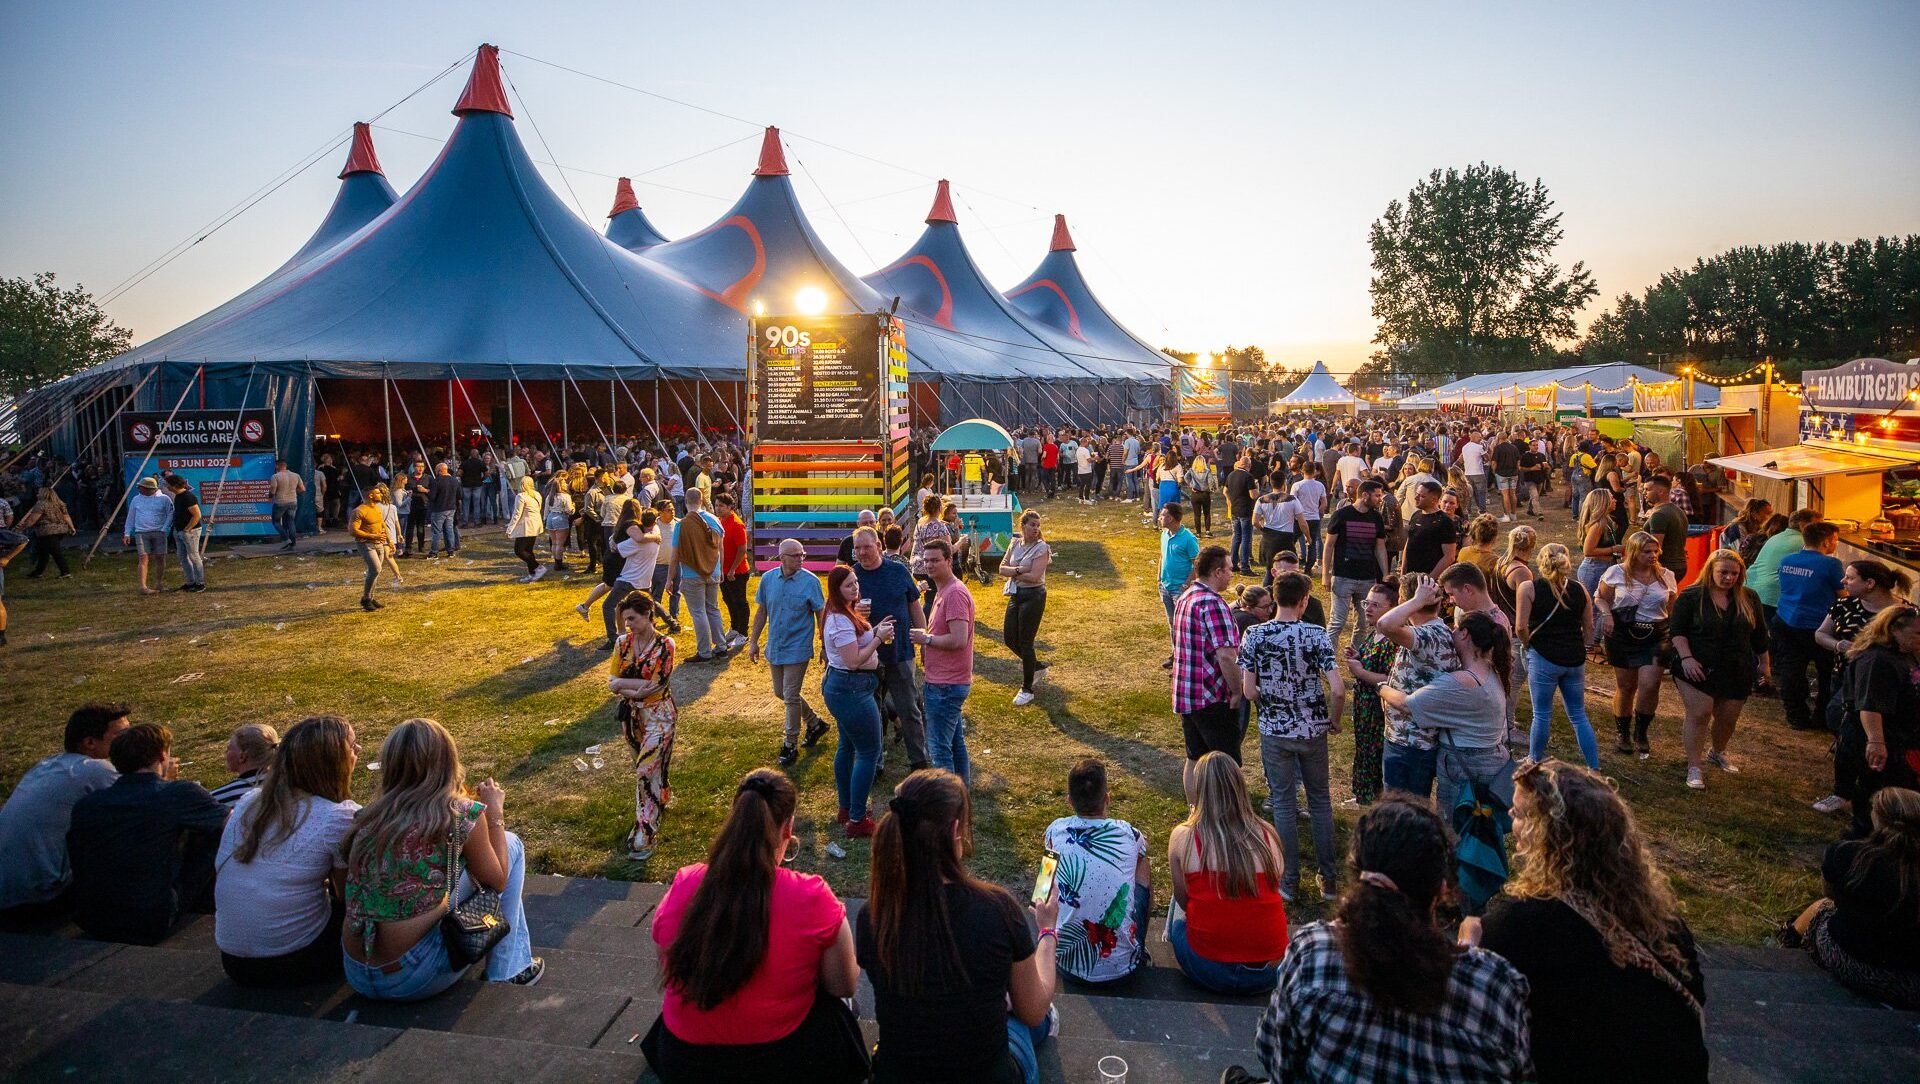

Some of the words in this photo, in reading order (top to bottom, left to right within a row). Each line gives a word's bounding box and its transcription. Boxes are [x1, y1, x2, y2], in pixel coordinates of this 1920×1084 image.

[766, 325, 811, 348] 90s
[1818, 372, 1920, 401] HAMBURGERS
[156, 421, 182, 432] THIS
[185, 421, 196, 431] IS
[198, 420, 206, 430] A
[208, 420, 234, 430] NON
[154, 433, 209, 444] SMOKING
[211, 432, 241, 443] AREA
[168, 459, 179, 467] 18
[181, 459, 205, 467] JUNI
[1782, 565, 1814, 578] SECURITY
